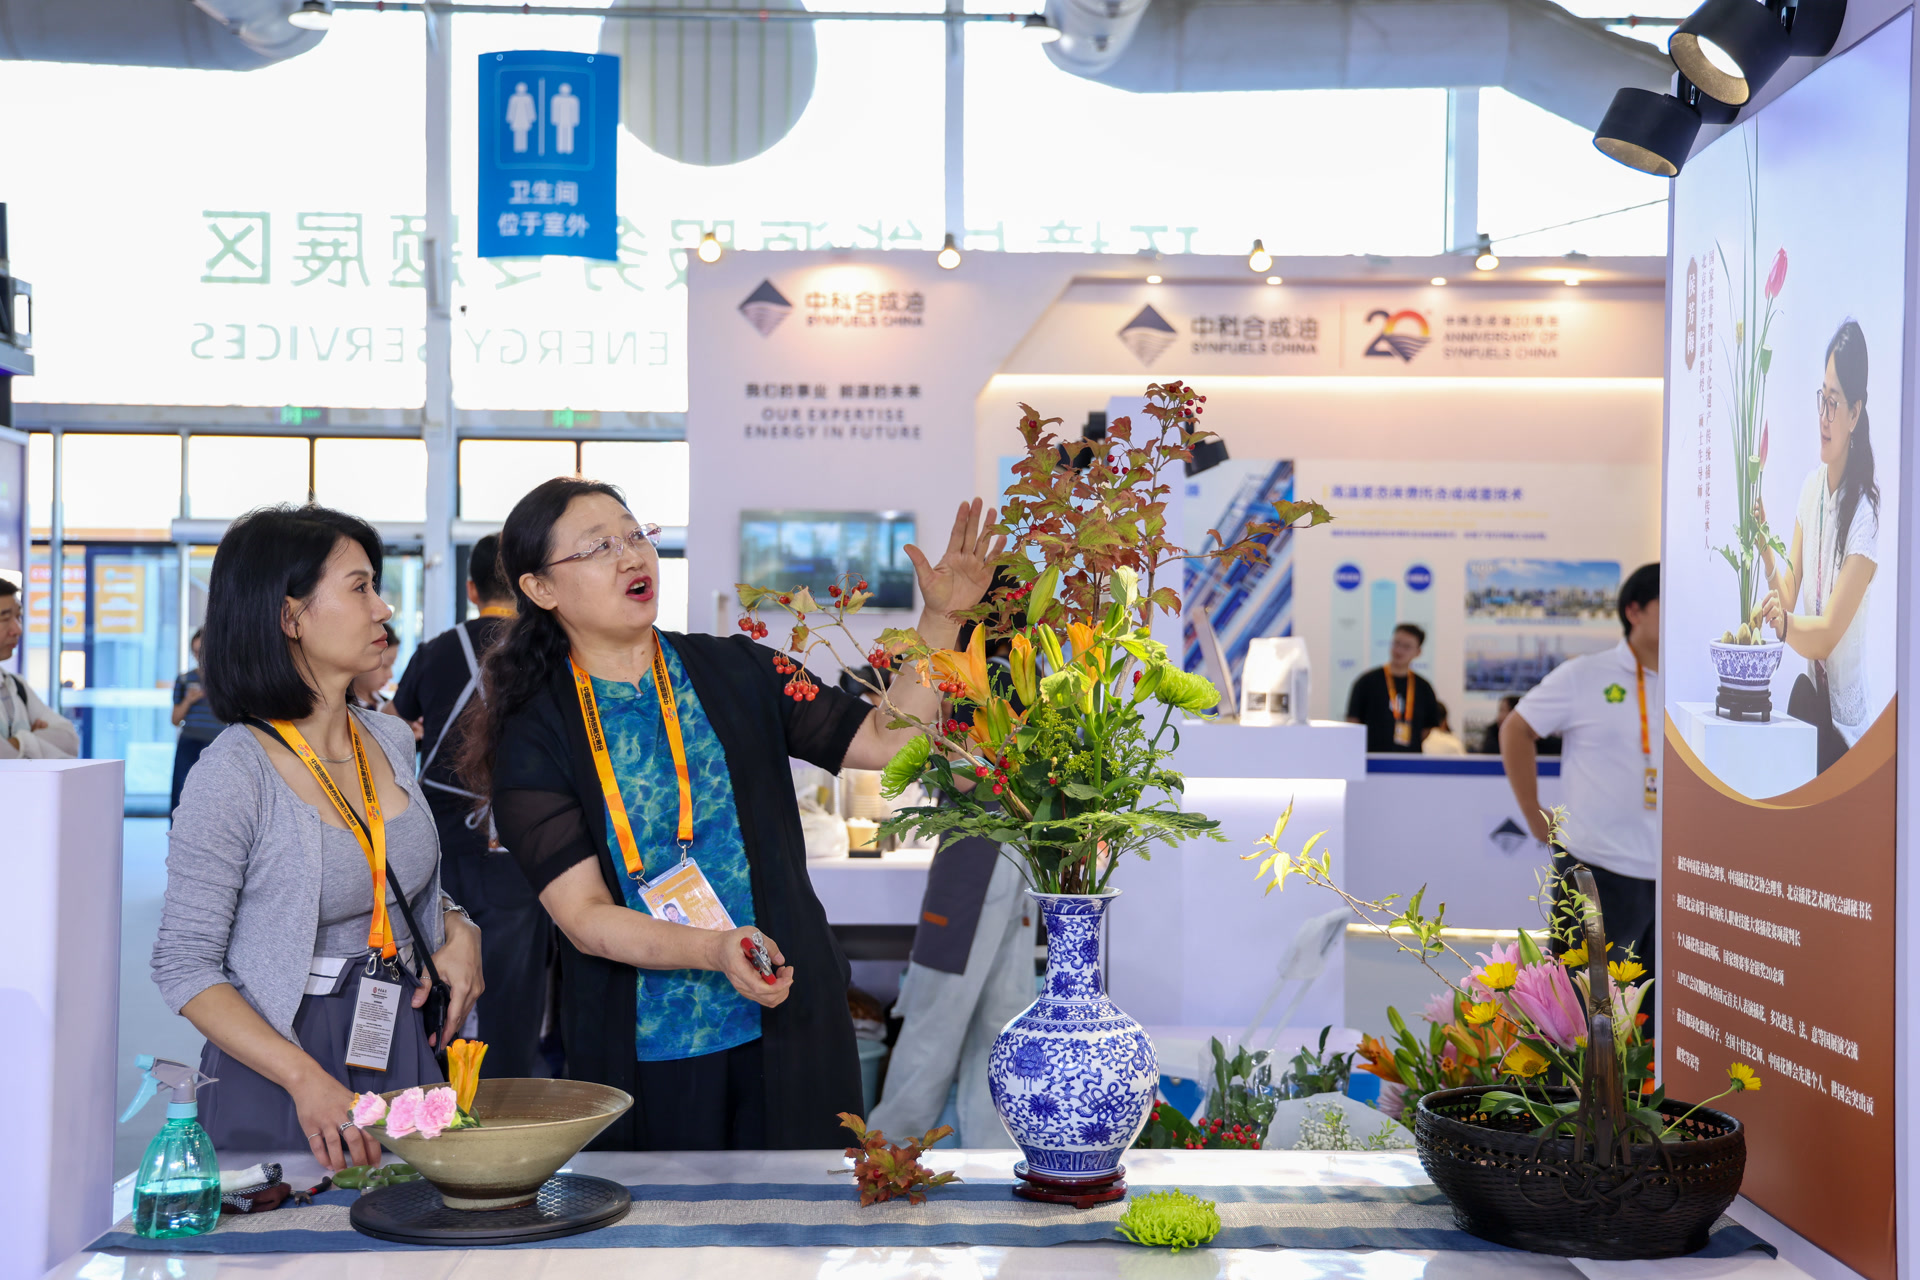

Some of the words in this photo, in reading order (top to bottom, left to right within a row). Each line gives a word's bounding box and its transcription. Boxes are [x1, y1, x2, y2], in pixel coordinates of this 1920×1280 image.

[508, 179, 579, 206] 卫生间
[497, 211, 590, 238] 位于室外
[805, 291, 926, 314] 中科合成油
[806, 315, 877, 328] SYNFUELS
[881, 315, 925, 328] CHINA
[1190, 315, 1318, 341] 中科合成油
[1444, 331, 1536, 343] ANNIVERSARY
[1539, 331, 1559, 343] OF
[1190, 341, 1267, 355] SYNFUELS
[1271, 341, 1317, 355] CHINA
[1444, 346, 1511, 359] SYNFUELS
[1515, 346, 1558, 359] CHINA
[746, 384, 827, 398] 我们的事业
[840, 384, 921, 398] 能源的未来
[761, 407, 800, 421] OUR
[807, 408, 904, 422] EXPERTISE
[745, 425, 817, 439] ENERGY
[823, 425, 844, 439] IN
[850, 425, 921, 440] FUTURE
